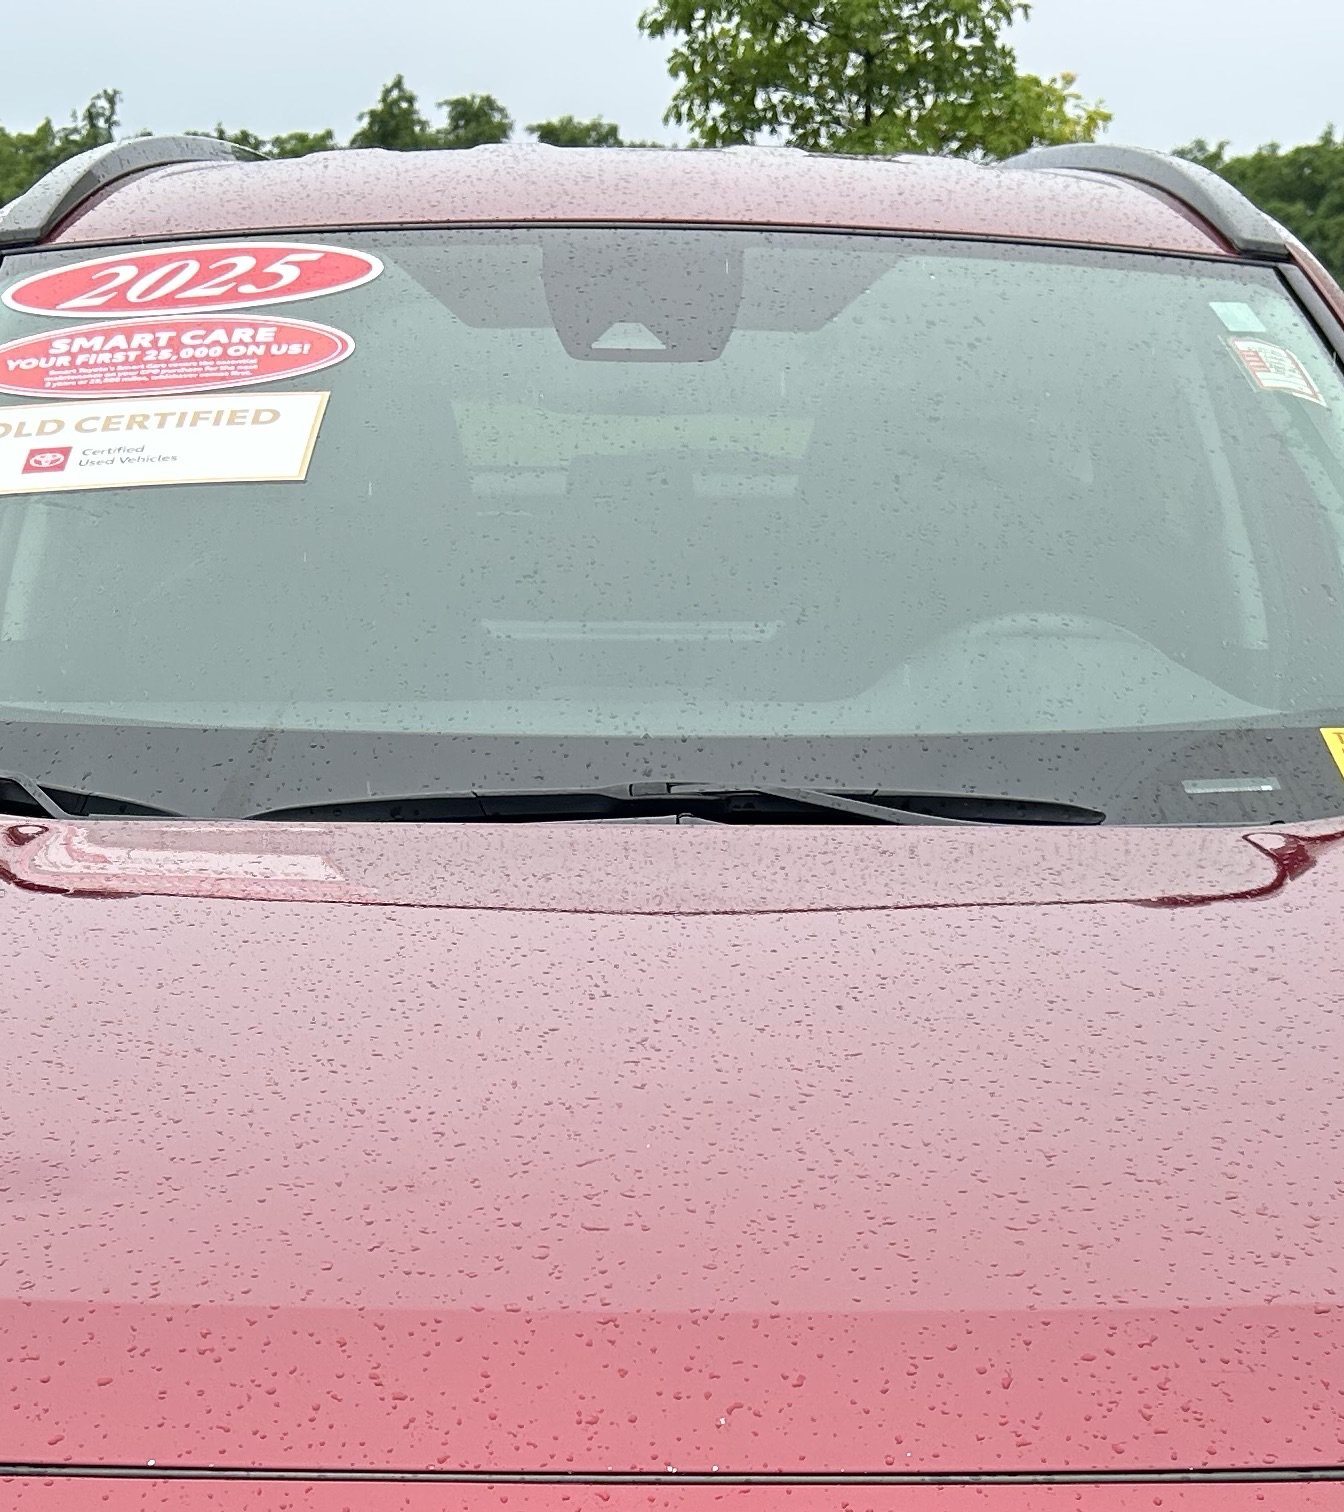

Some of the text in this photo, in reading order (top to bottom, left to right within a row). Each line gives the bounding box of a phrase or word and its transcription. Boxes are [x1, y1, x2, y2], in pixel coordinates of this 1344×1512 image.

[55, 252, 325, 309] 2025
[48, 327, 278, 355] SMART CARE
[6, 343, 311, 371] YOUR FIRST 25,000 ON US!
[74, 408, 281, 434] CERTIFIED
[78, 454, 177, 467] Used Vehicles
[82, 444, 145, 456] Certified
